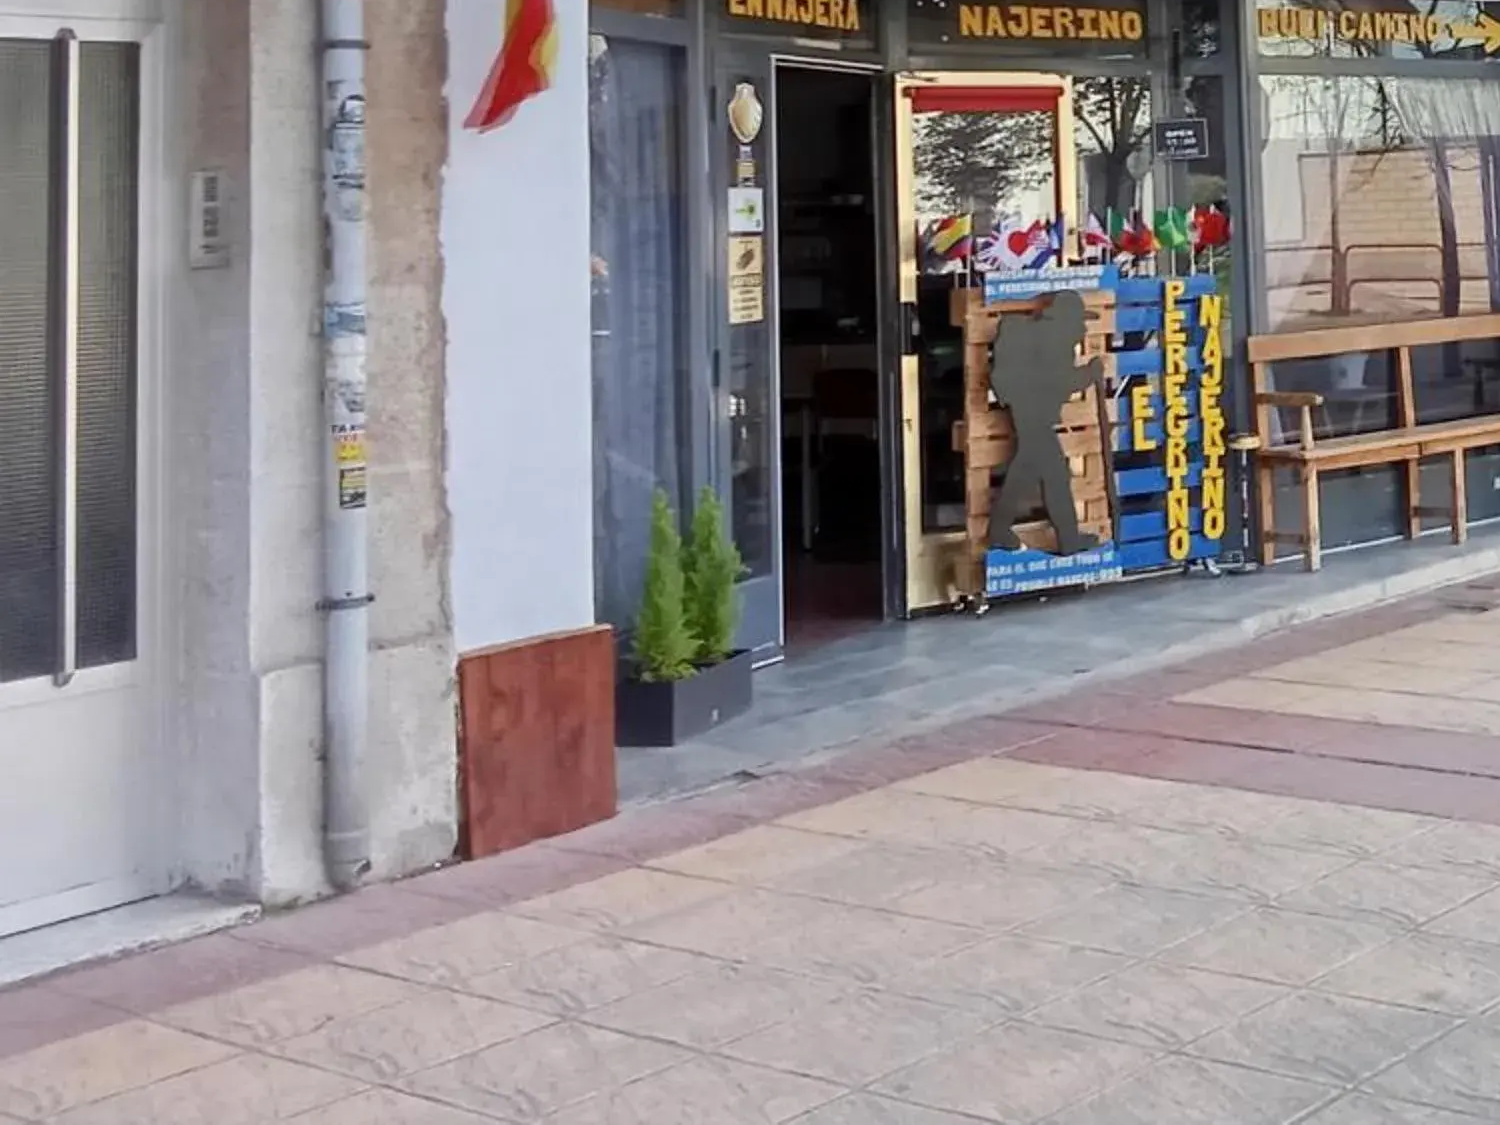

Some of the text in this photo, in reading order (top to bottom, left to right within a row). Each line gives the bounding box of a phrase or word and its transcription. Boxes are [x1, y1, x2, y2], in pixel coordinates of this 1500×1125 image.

[960, 4, 1143, 40] NAJERINO
[1258, 8, 1439, 43] BUEN CAMINO
[1132, 385, 1157, 452] EL
[1165, 280, 1190, 561] PEREGRINO
[1201, 294, 1226, 540] NAJERINO
